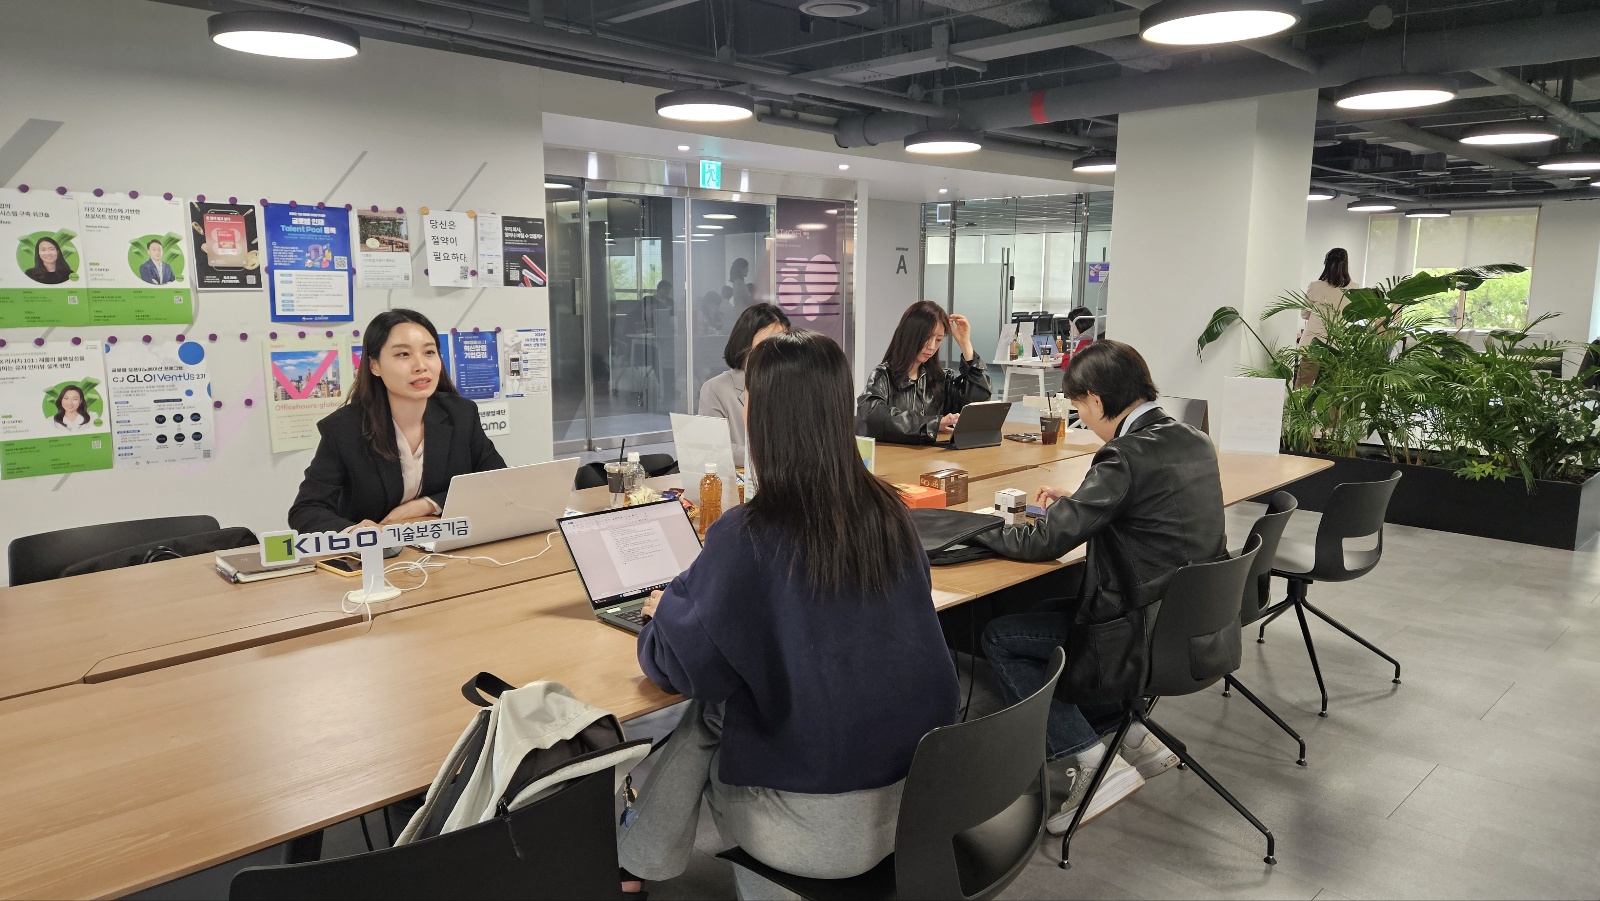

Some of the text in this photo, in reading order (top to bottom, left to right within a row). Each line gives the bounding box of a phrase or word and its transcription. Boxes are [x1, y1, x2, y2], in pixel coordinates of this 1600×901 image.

[430, 220, 456, 230] 당신은
[431, 236, 457, 246] 절약이
[433, 252, 467, 262] 필요하다.
[896, 255, 907, 274] A
[482, 421, 506, 430] amp
[387, 520, 469, 542] 기술보증기금
